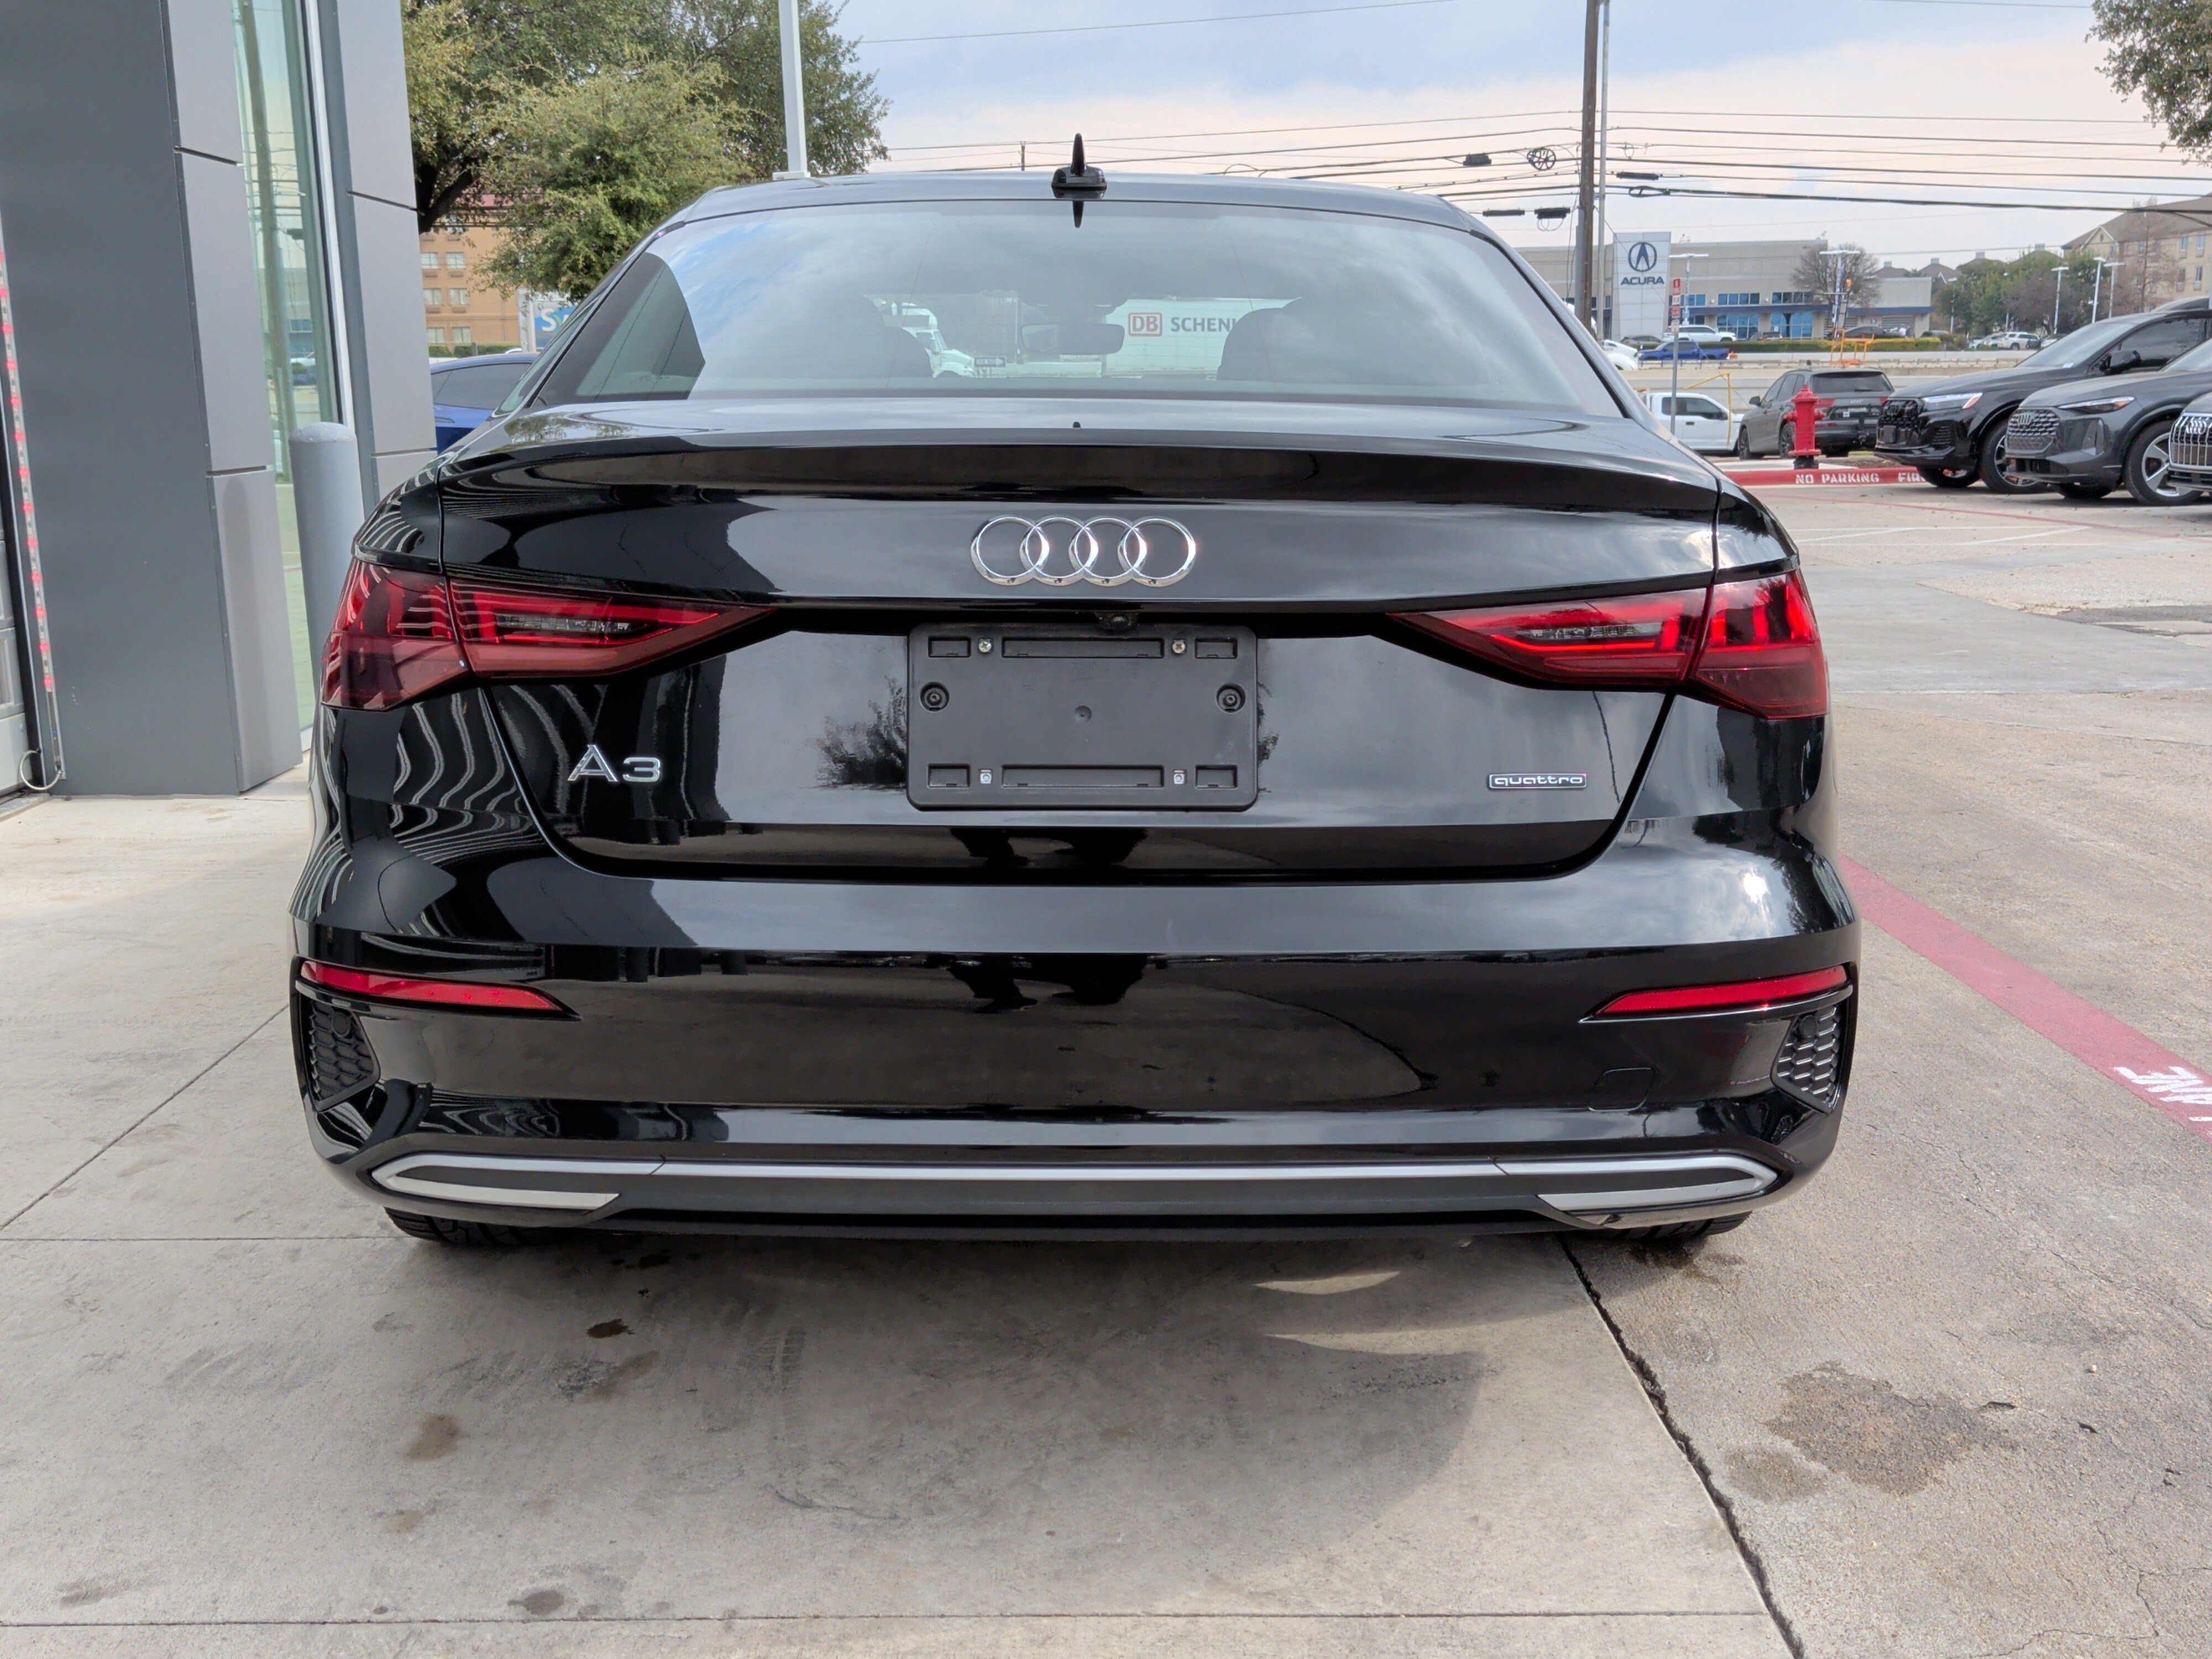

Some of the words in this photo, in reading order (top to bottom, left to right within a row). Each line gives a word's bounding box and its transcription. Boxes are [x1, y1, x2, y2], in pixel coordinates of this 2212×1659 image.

[1620, 276, 1665, 285] ACURA
[1131, 315, 1159, 333] DB
[1796, 474, 1814, 484] NO
[1822, 473, 1880, 484] PARKING
[1898, 472, 1926, 482] FIR
[567, 744, 660, 782] A3
[1495, 776, 1583, 786] quattro
